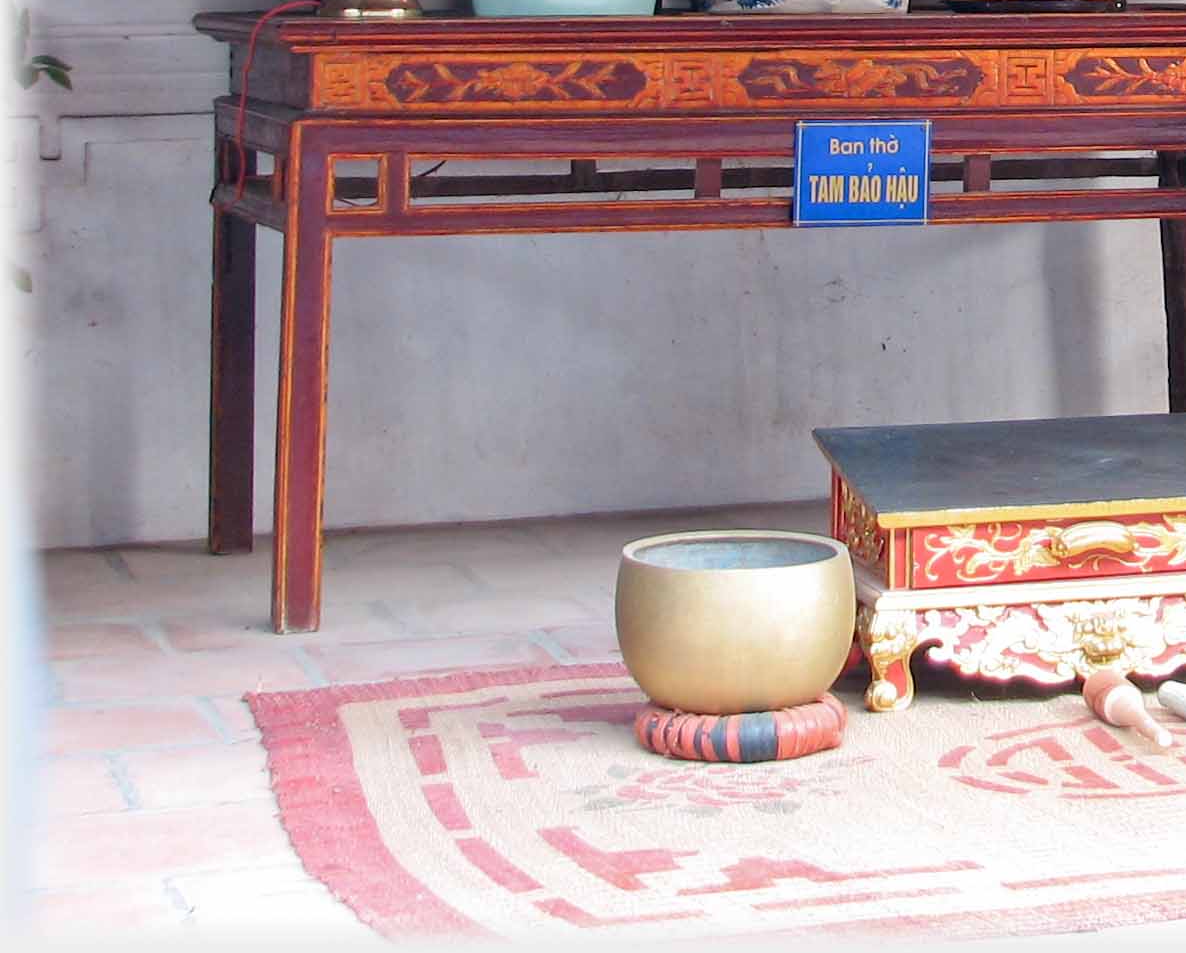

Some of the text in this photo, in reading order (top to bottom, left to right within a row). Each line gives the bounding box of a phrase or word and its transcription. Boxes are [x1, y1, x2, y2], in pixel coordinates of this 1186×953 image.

[829, 134, 899, 155] Ban thờ
[809, 162, 918, 209] TAM BẢO HẬU
